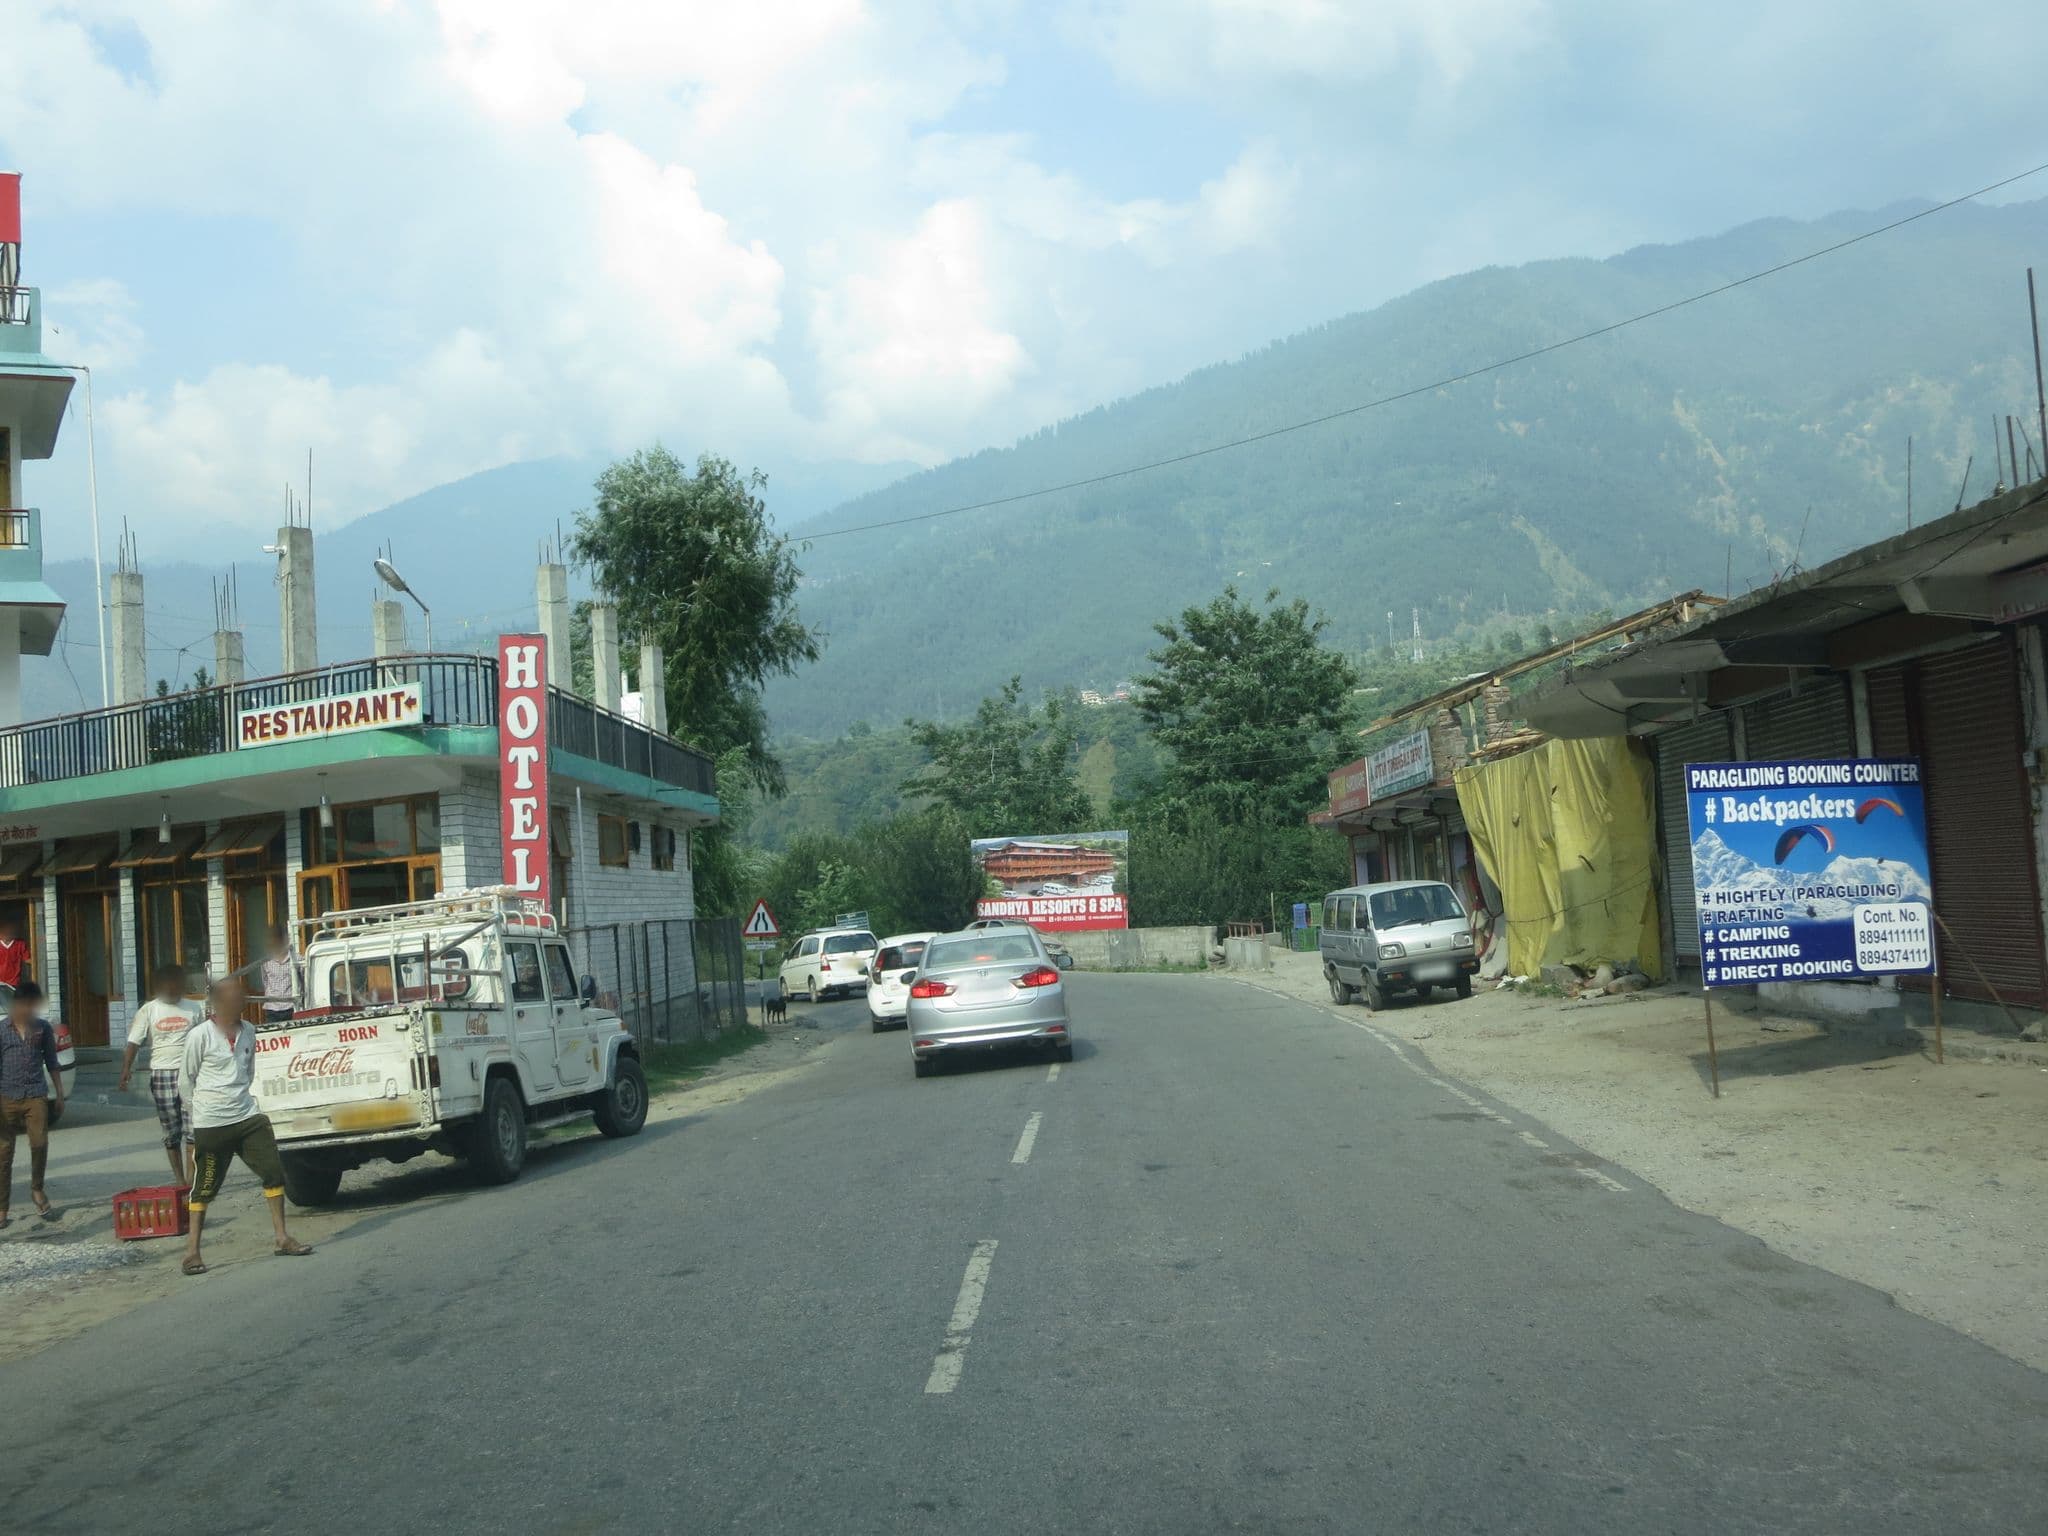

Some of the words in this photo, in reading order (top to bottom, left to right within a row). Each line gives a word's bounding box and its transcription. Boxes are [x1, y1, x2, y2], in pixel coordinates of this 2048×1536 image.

[242, 691, 405, 742] RESTAURANT
[505, 646, 540, 891] HOTEL
[1692, 768, 1784, 788] PARAGLIDING
[1788, 765, 1850, 784] BOOKING
[1855, 764, 1918, 782] COUNTER
[1706, 798, 1716, 823] #
[1722, 793, 1855, 826] Backpackers
[1760, 888, 1785, 901] FLY
[1792, 884, 1901, 902] (PARAGLIDING)
[977, 900, 1029, 916] SANDHYA
[1032, 898, 1086, 915] RESORTS
[1089, 899, 1097, 912] &
[1100, 897, 1122, 912] SPA
[1717, 908, 1784, 923] RAFTING
[1863, 910, 1895, 924] Cont.
[1900, 908, 1919, 922] No.
[1719, 926, 1789, 942] CAMPING
[1859, 929, 1925, 944] 8894111111
[1720, 945, 1800, 960] TREKKING
[1860, 949, 1928, 964] 8894374111
[1721, 965, 1777, 980] DIRECT
[1783, 960, 1853, 976] BOOKING
[255, 1036, 291, 1052] BLOW
[338, 1026, 378, 1042] HORN
